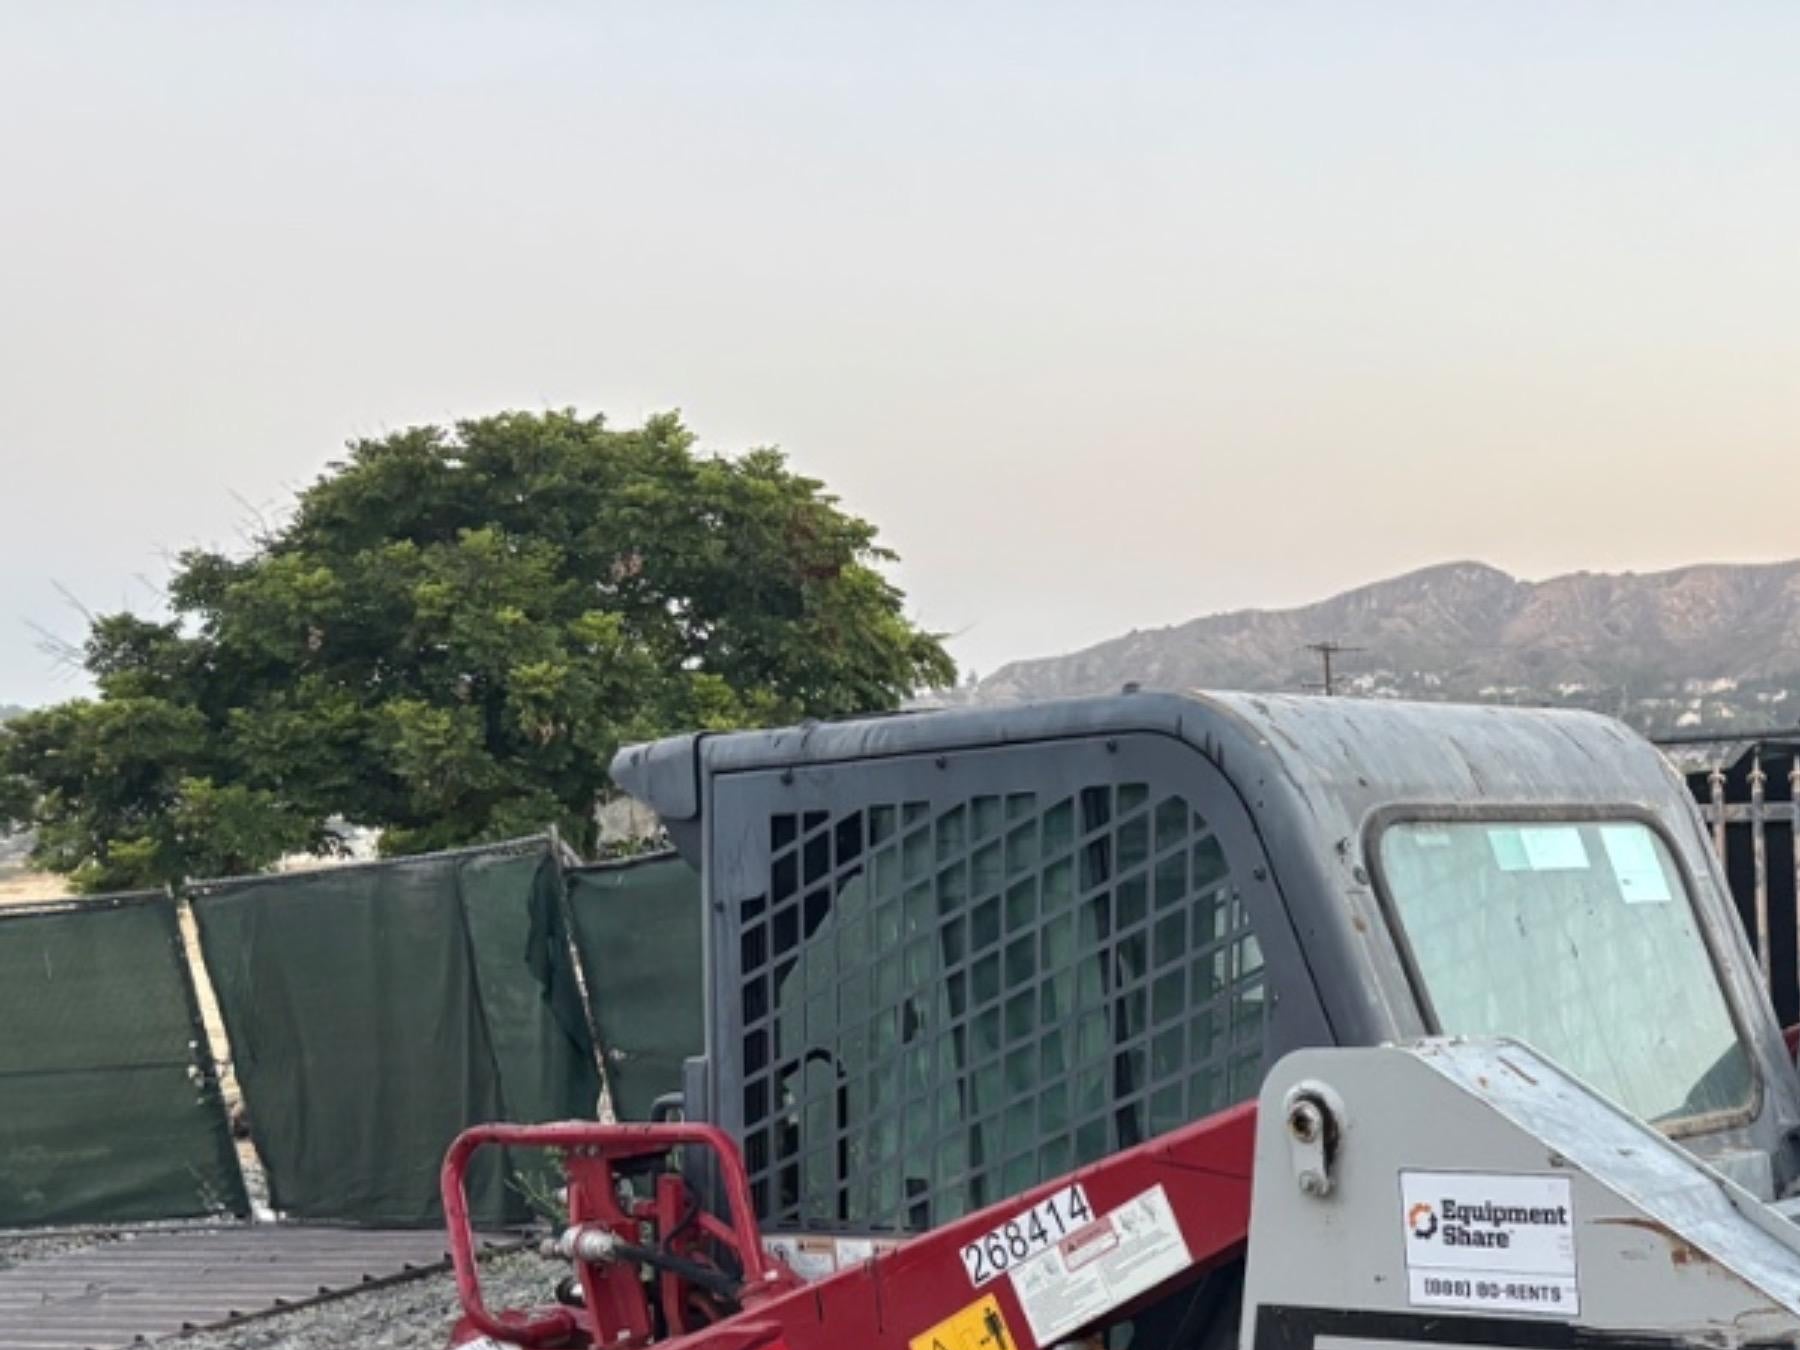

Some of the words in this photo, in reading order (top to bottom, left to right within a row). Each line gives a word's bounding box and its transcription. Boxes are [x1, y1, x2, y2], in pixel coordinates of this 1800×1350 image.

[1440, 1199, 1567, 1228] Equipment
[964, 1184, 1092, 1285] 268414
[1442, 1225, 1509, 1248] Share
